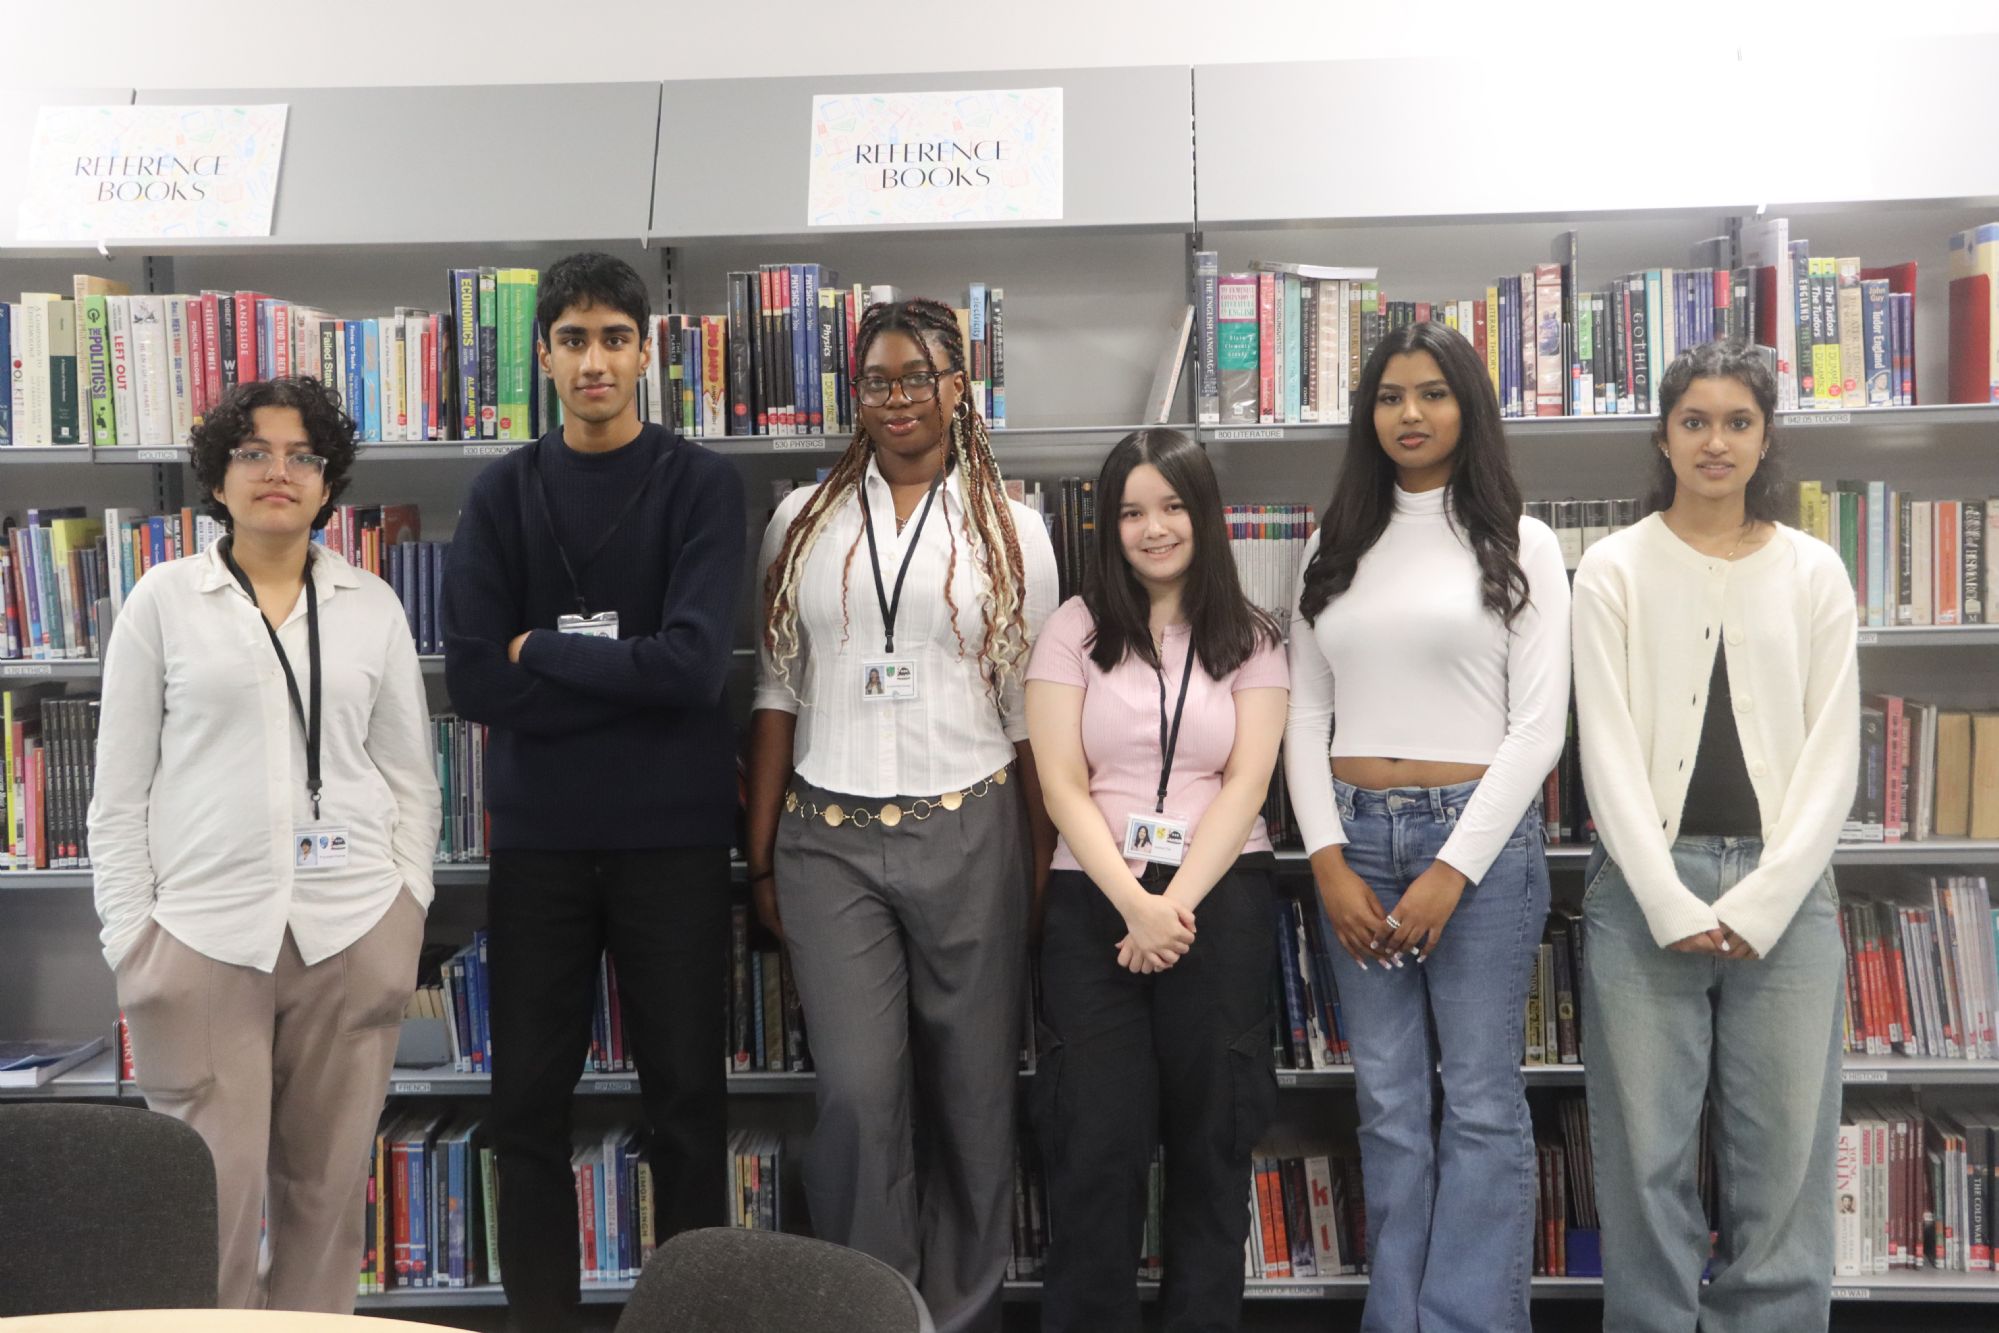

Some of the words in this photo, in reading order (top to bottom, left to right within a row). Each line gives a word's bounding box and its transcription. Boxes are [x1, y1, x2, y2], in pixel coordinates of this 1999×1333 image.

[857, 140, 1009, 164] REFERENCE
[75, 155, 227, 176] REFERENCE
[882, 165, 990, 189] BOOKS
[97, 180, 206, 202] BOOKS
[791, 274, 800, 307] PHYSICS
[805, 274, 813, 307] PHYSICS
[1812, 286, 1822, 304] The
[1826, 285, 1836, 303] The
[1869, 286, 1886, 295] John
[1869, 294, 1885, 303] Guy
[205, 308, 215, 339] REVENGE
[461, 278, 474, 346] ECONOMICS
[792, 319, 800, 330] You
[806, 319, 814, 330] You
[972, 296, 982, 338] electricity
[1205, 296, 1213, 330] ENGLISH
[1488, 303, 1497, 338] LITERARY
[1813, 305, 1824, 337] Tudors
[1827, 305, 1838, 336] Tudors
[1872, 310, 1884, 333] Tudor
[239, 299, 249, 356] LANDSLIDE
[277, 311, 286, 341] BEYOND
[114, 335, 126, 361] LEFT
[277, 342, 286, 355] THE
[323, 331, 333, 360] Failed
[823, 324, 832, 357] Physics
[1205, 331, 1214, 374] LANGUAGE
[1633, 312, 1647, 385] GOTHIC
[1872, 335, 1885, 369] England
[89, 336, 106, 394] POLITICS
[207, 347, 216, 371] POWER
[278, 356, 287, 372] RED
[1489, 341, 1498, 370] THEORY
[116, 364, 127, 391] OUT
[324, 362, 334, 388] State
[467, 376, 476, 398] ALAIN
[774, 441, 788, 449] 530
[789, 439, 824, 449] PHYSICS
[1218, 431, 1231, 439] 800
[1233, 430, 1281, 438] LITERATURE
[1965, 550, 1979, 601] BISMARCK
[397, 1083, 430, 1092] FRENCH
[1850, 1071, 1886, 1081] HISTORY
[1836, 1136, 1850, 1190] STALIN
[1849, 1146, 1857, 1181] YOUNG
[640, 1169, 648, 1202] SIMON
[1973, 1178, 1981, 1195] THE
[641, 1206, 649, 1237] SINGH
[1974, 1197, 1982, 1223] COLD
[1974, 1224, 1983, 1244] WAR
[1848, 1289, 1868, 1298] WAR
